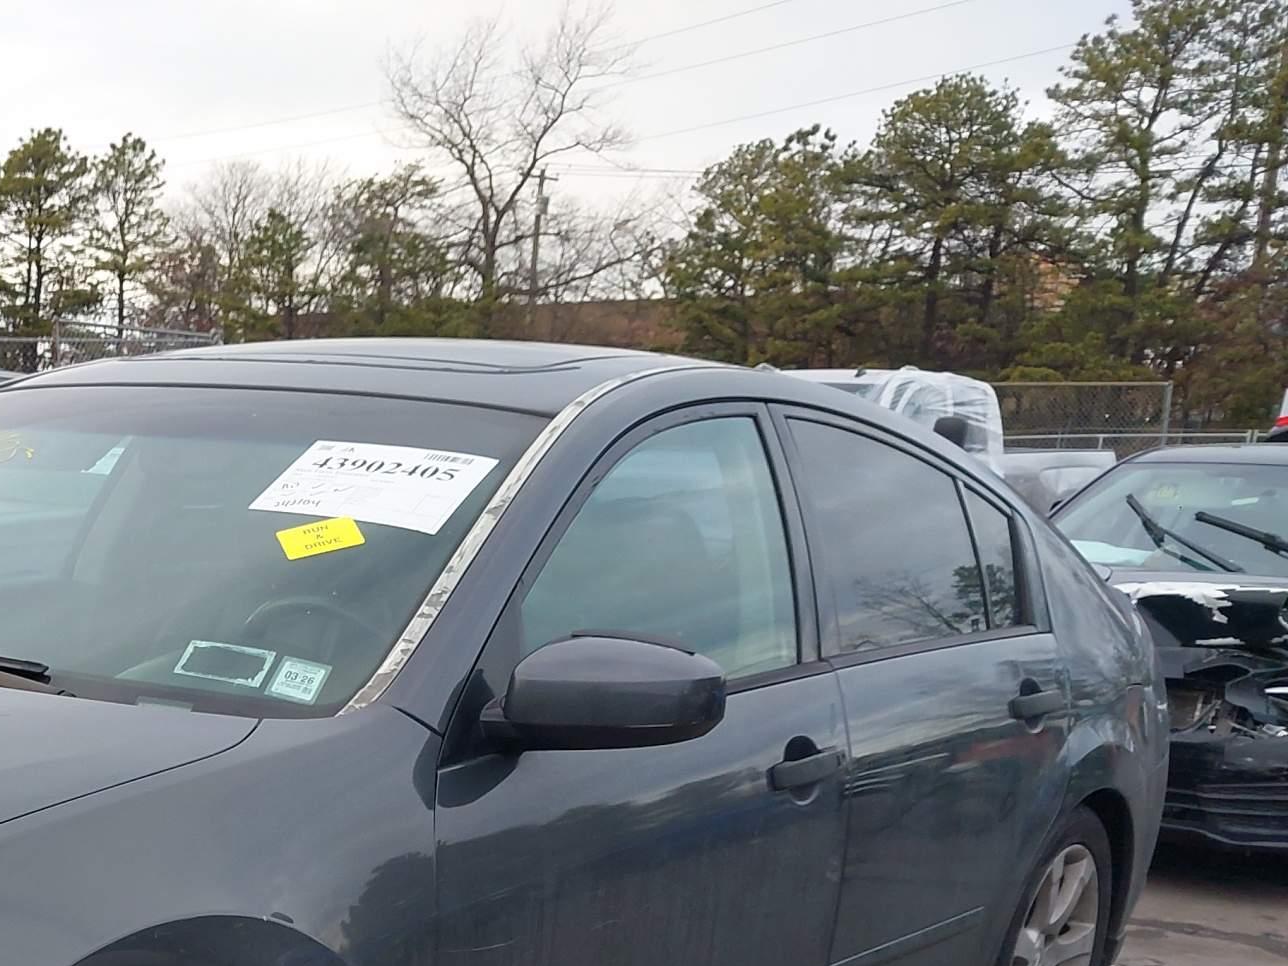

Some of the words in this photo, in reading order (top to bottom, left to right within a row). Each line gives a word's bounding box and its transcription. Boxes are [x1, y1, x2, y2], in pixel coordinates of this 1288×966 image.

[312, 456, 462, 482] 43902405
[302, 524, 329, 535] RUN
[304, 536, 344, 551] DRIVE
